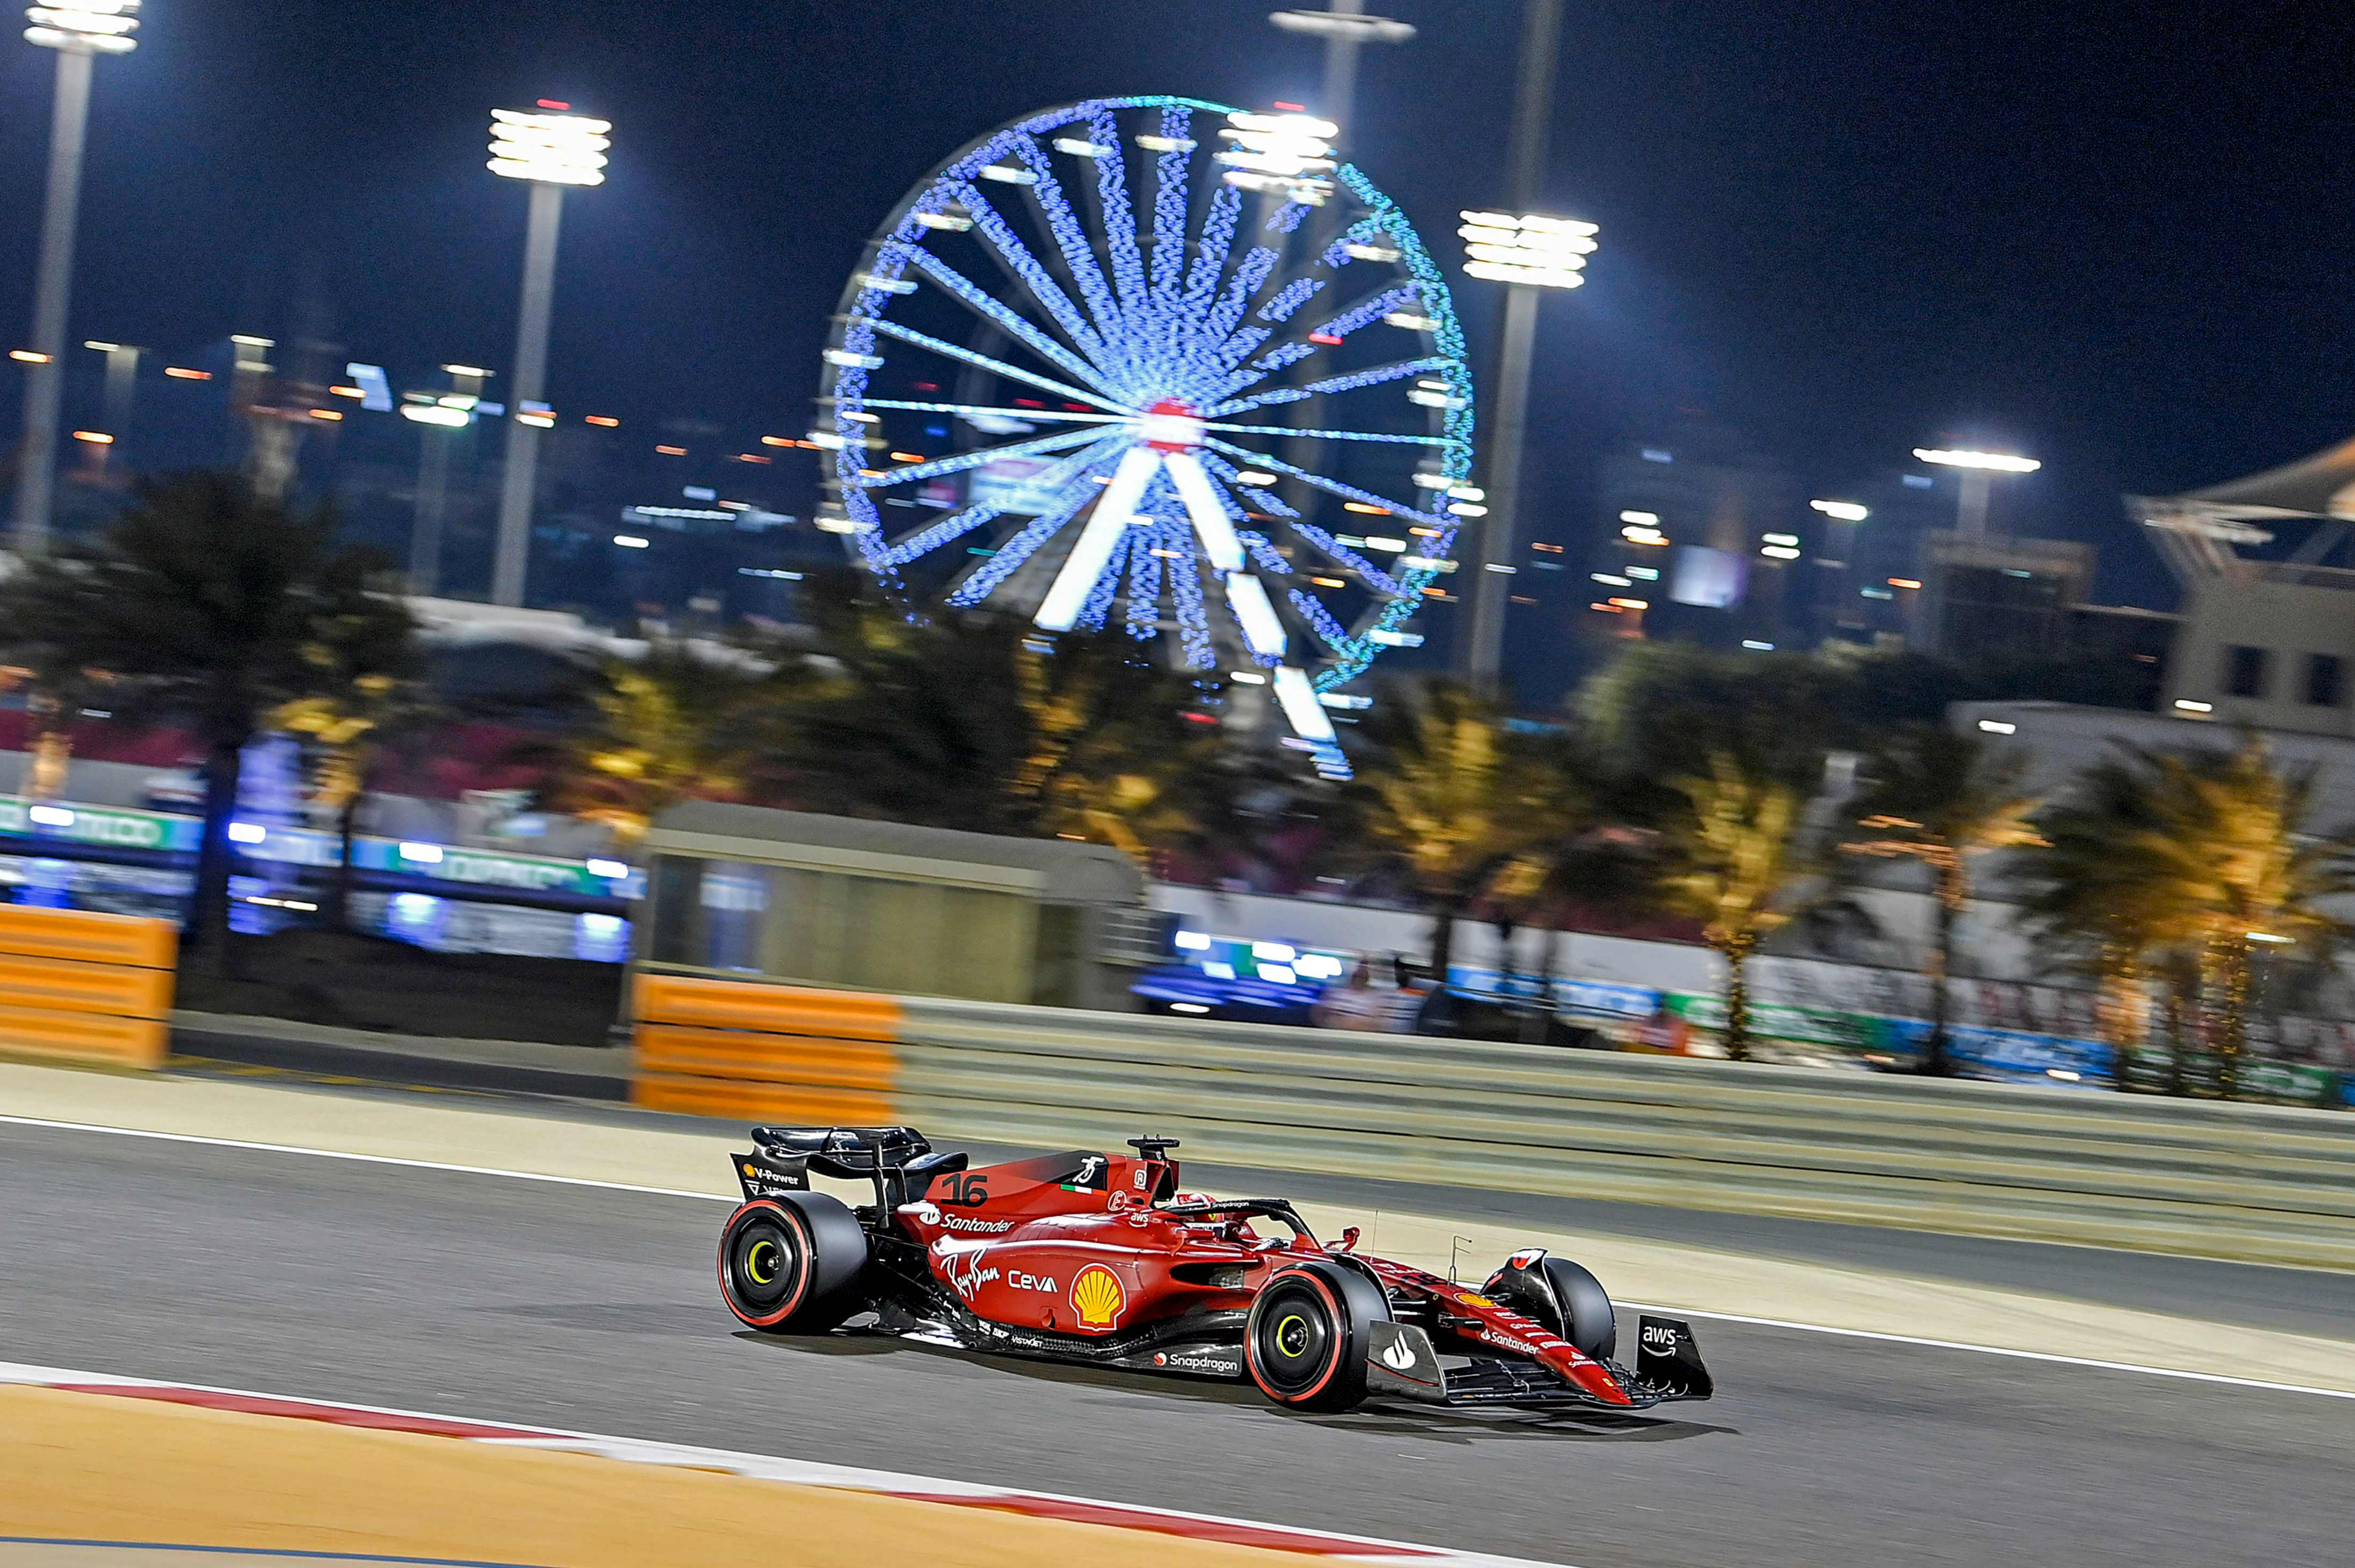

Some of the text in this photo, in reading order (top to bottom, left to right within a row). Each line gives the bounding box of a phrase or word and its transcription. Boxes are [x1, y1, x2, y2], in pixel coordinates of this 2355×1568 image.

[754, 1168, 799, 1185] V-Power
[940, 1173, 988, 1208] 16
[940, 1213, 1015, 1232] Santander
[1131, 1212, 1149, 1223] aws
[1491, 1332, 1540, 1355] Santander
[1643, 1326, 1676, 1345] aws
[1169, 1354, 1238, 1372] Snapdragon
